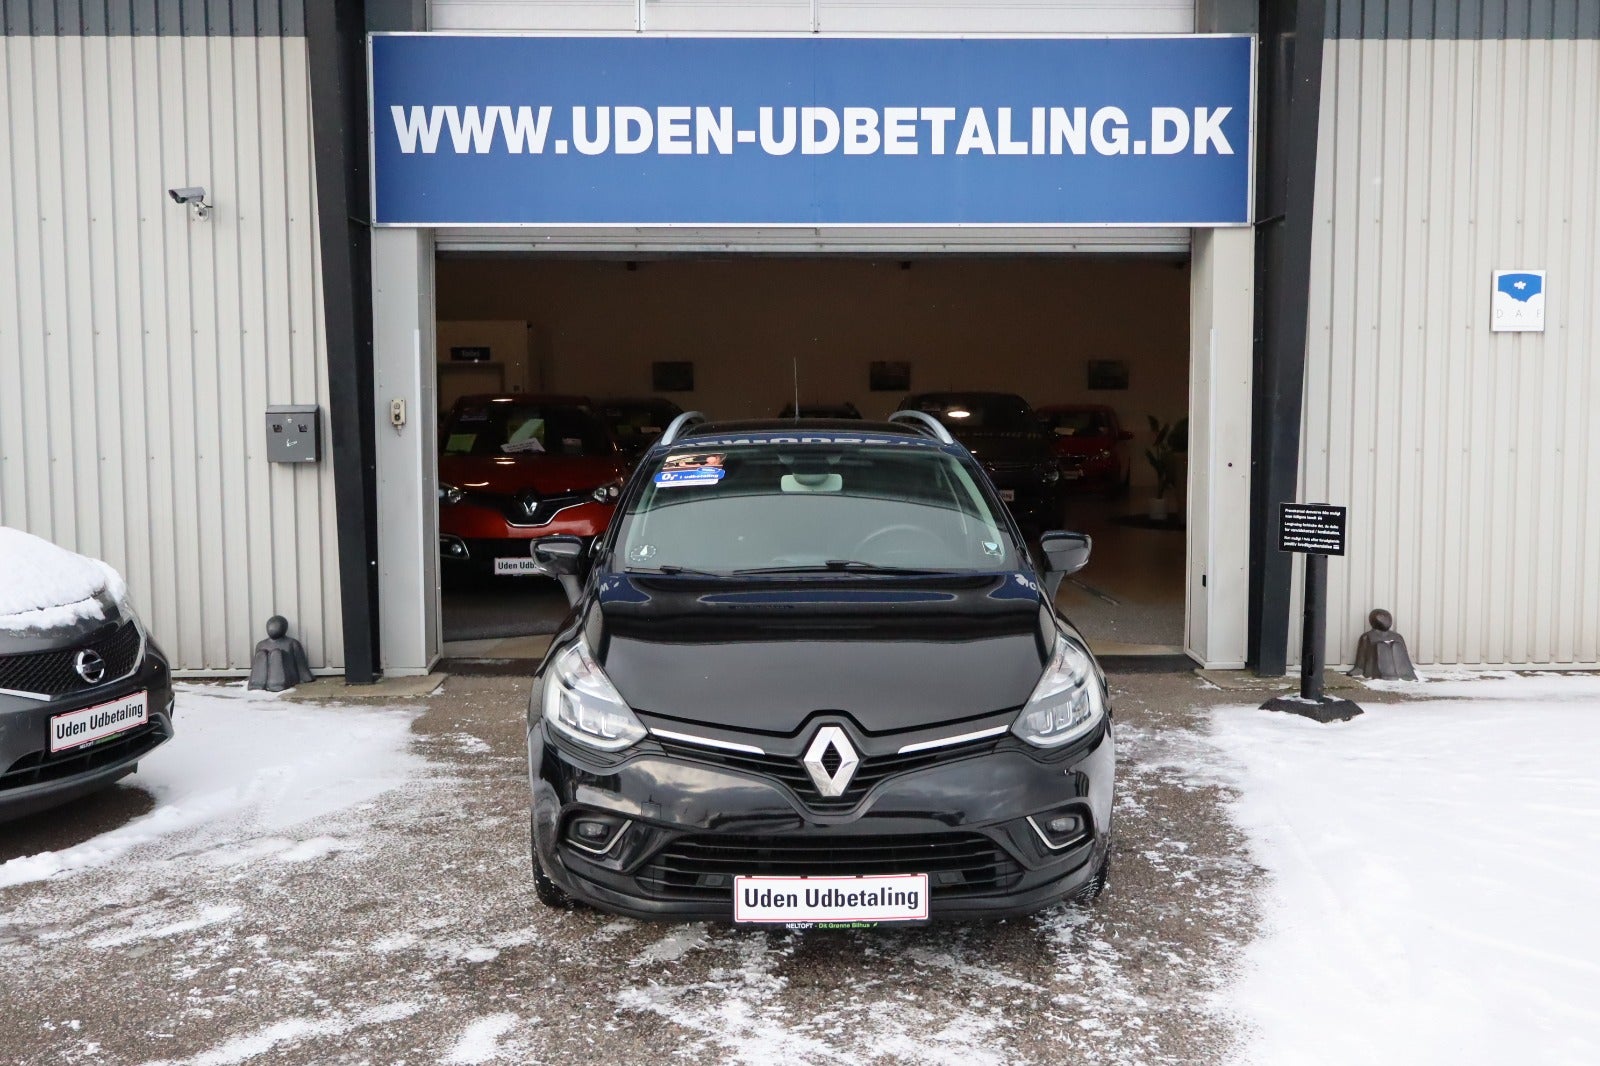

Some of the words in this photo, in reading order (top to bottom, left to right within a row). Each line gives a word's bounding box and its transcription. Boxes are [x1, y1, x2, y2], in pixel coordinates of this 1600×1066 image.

[390, 104, 1235, 157] WWW.UDEN-UDBETALING.DK
[498, 561, 518, 569] Uden
[519, 561, 537, 569] Udb
[56, 721, 86, 740] Uden
[90, 703, 143, 730] Udbetaling
[744, 888, 799, 908] Uden
[805, 887, 919, 910] Udbetaling
